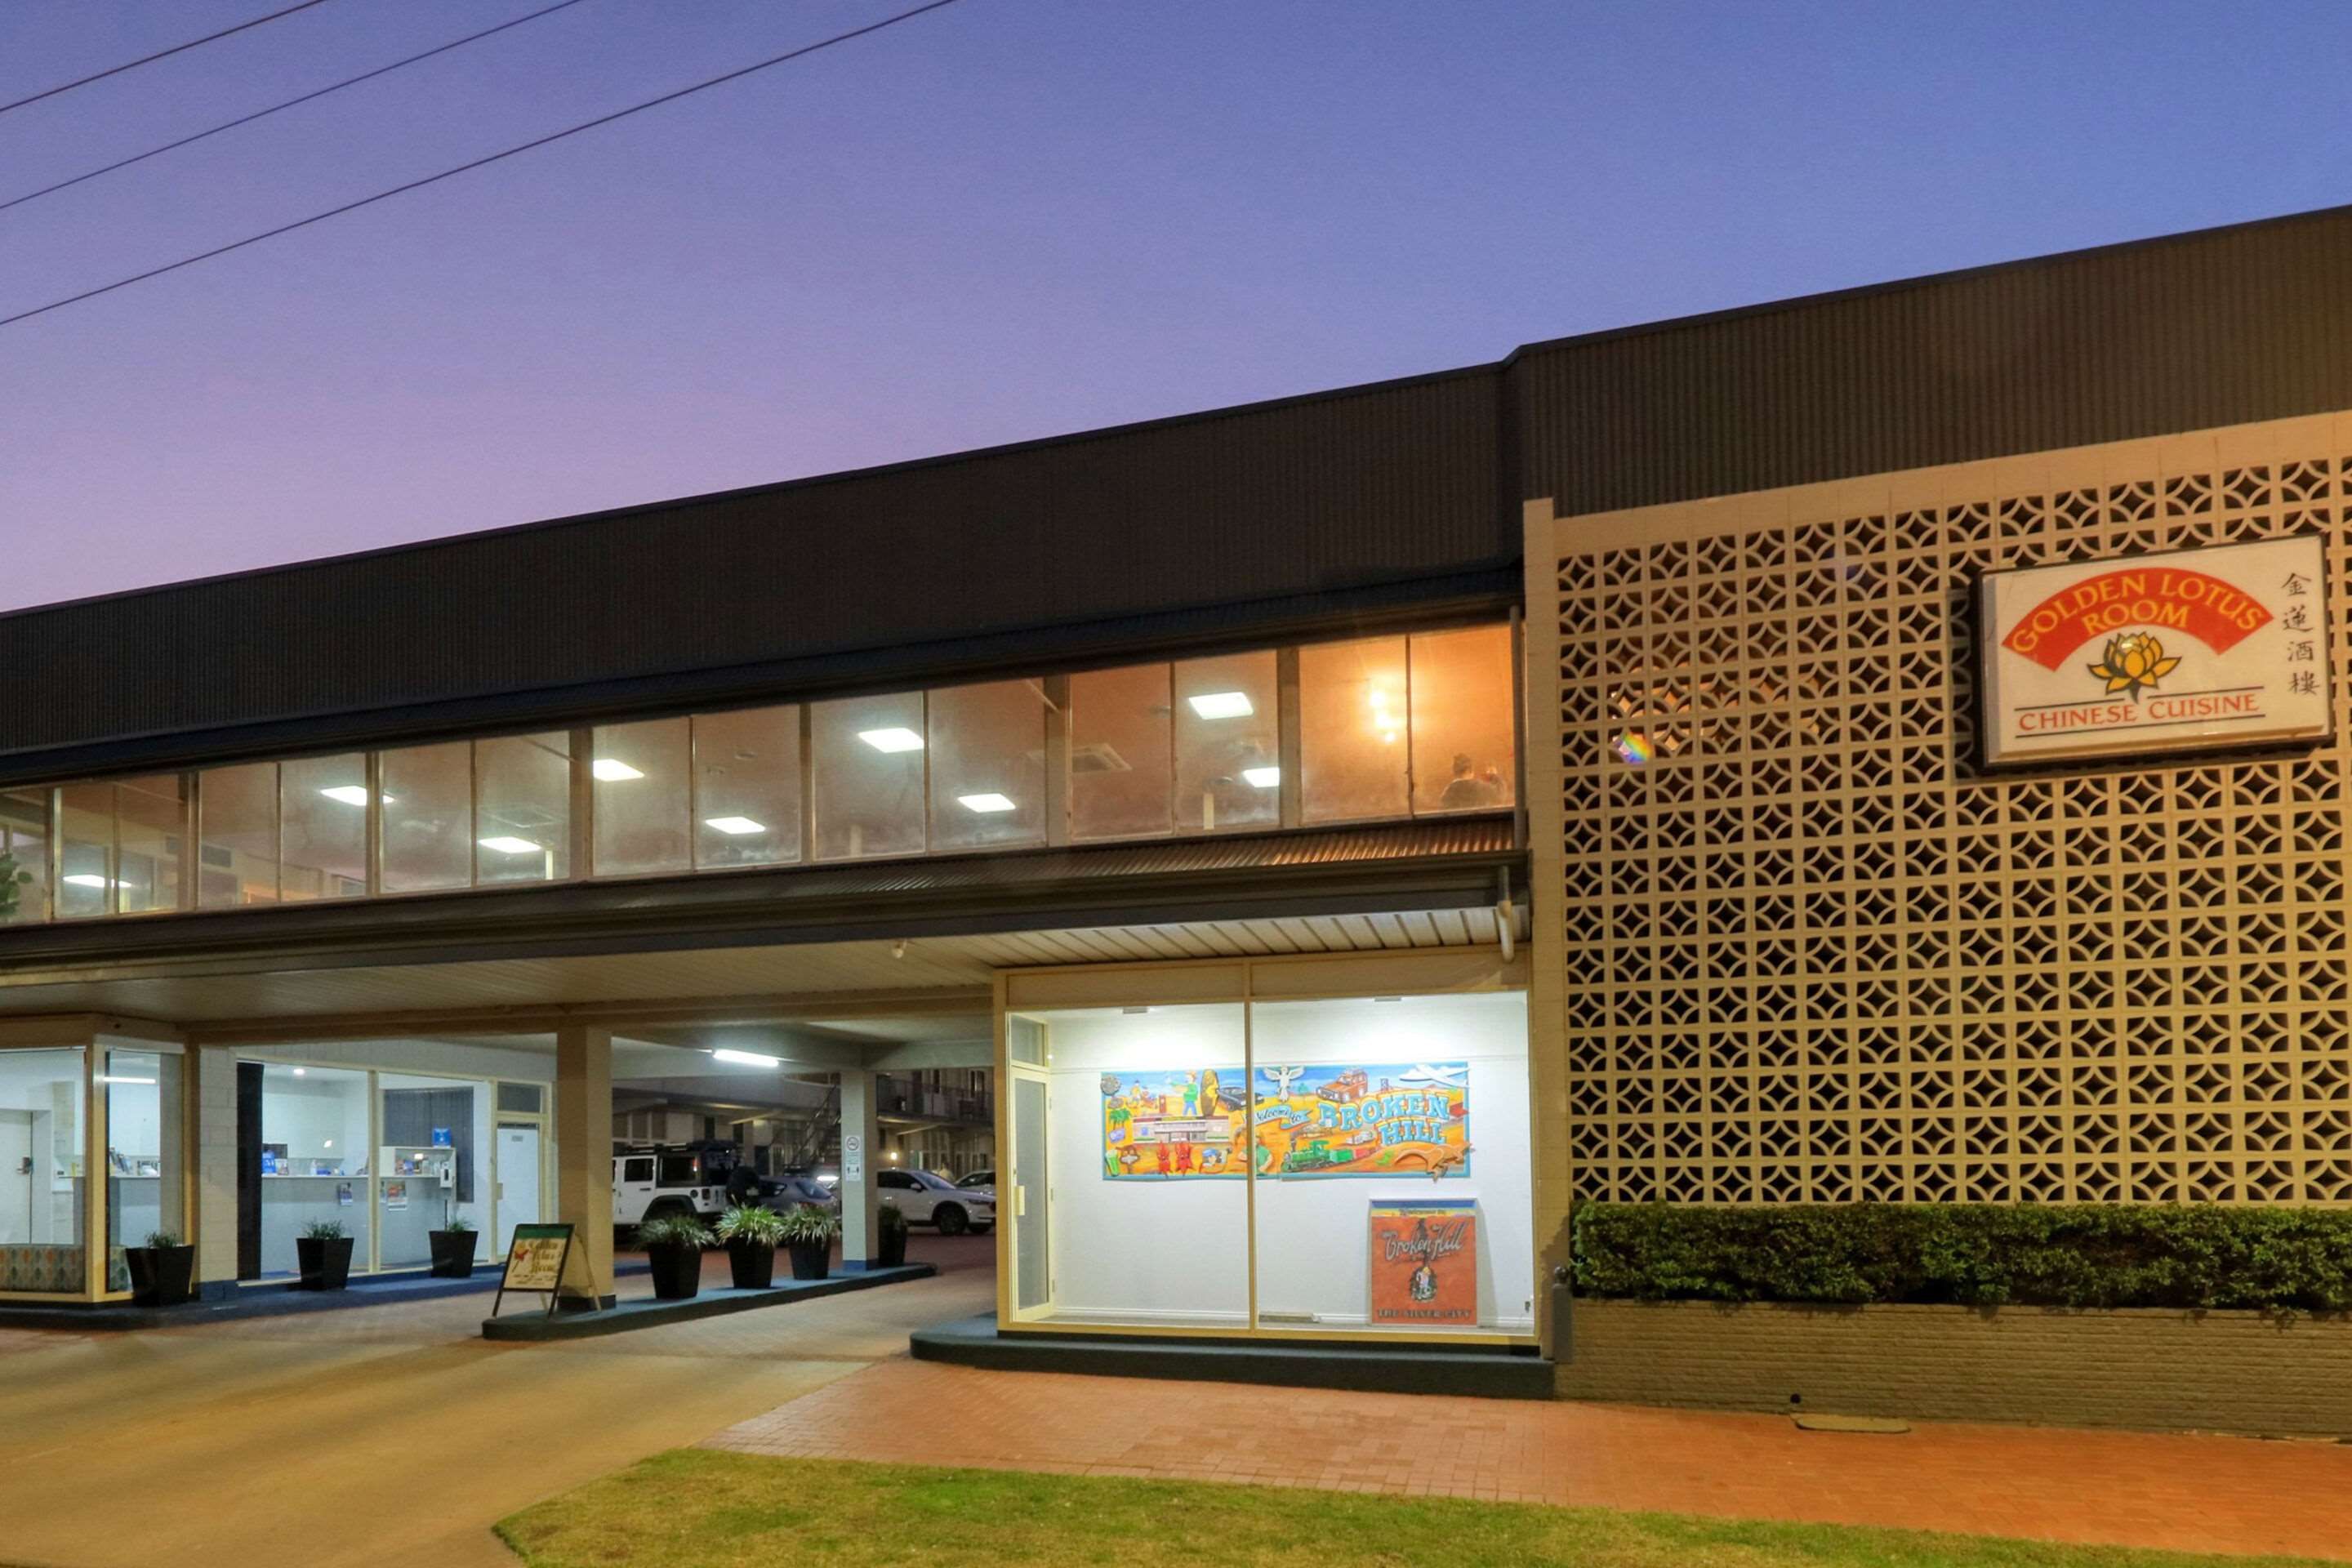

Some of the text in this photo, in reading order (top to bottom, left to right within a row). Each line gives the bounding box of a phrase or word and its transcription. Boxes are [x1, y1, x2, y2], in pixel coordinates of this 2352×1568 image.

[2012, 572, 2264, 654] GOLDEN LOTUS
[2082, 599, 2190, 636] ROOM
[2019, 693, 2260, 732] CHINESE CUISINE
[1318, 1093, 1450, 1131] BROKEN
[1379, 1119, 1446, 1145] HILL
[1380, 1221, 1468, 1261] Broken Hill
